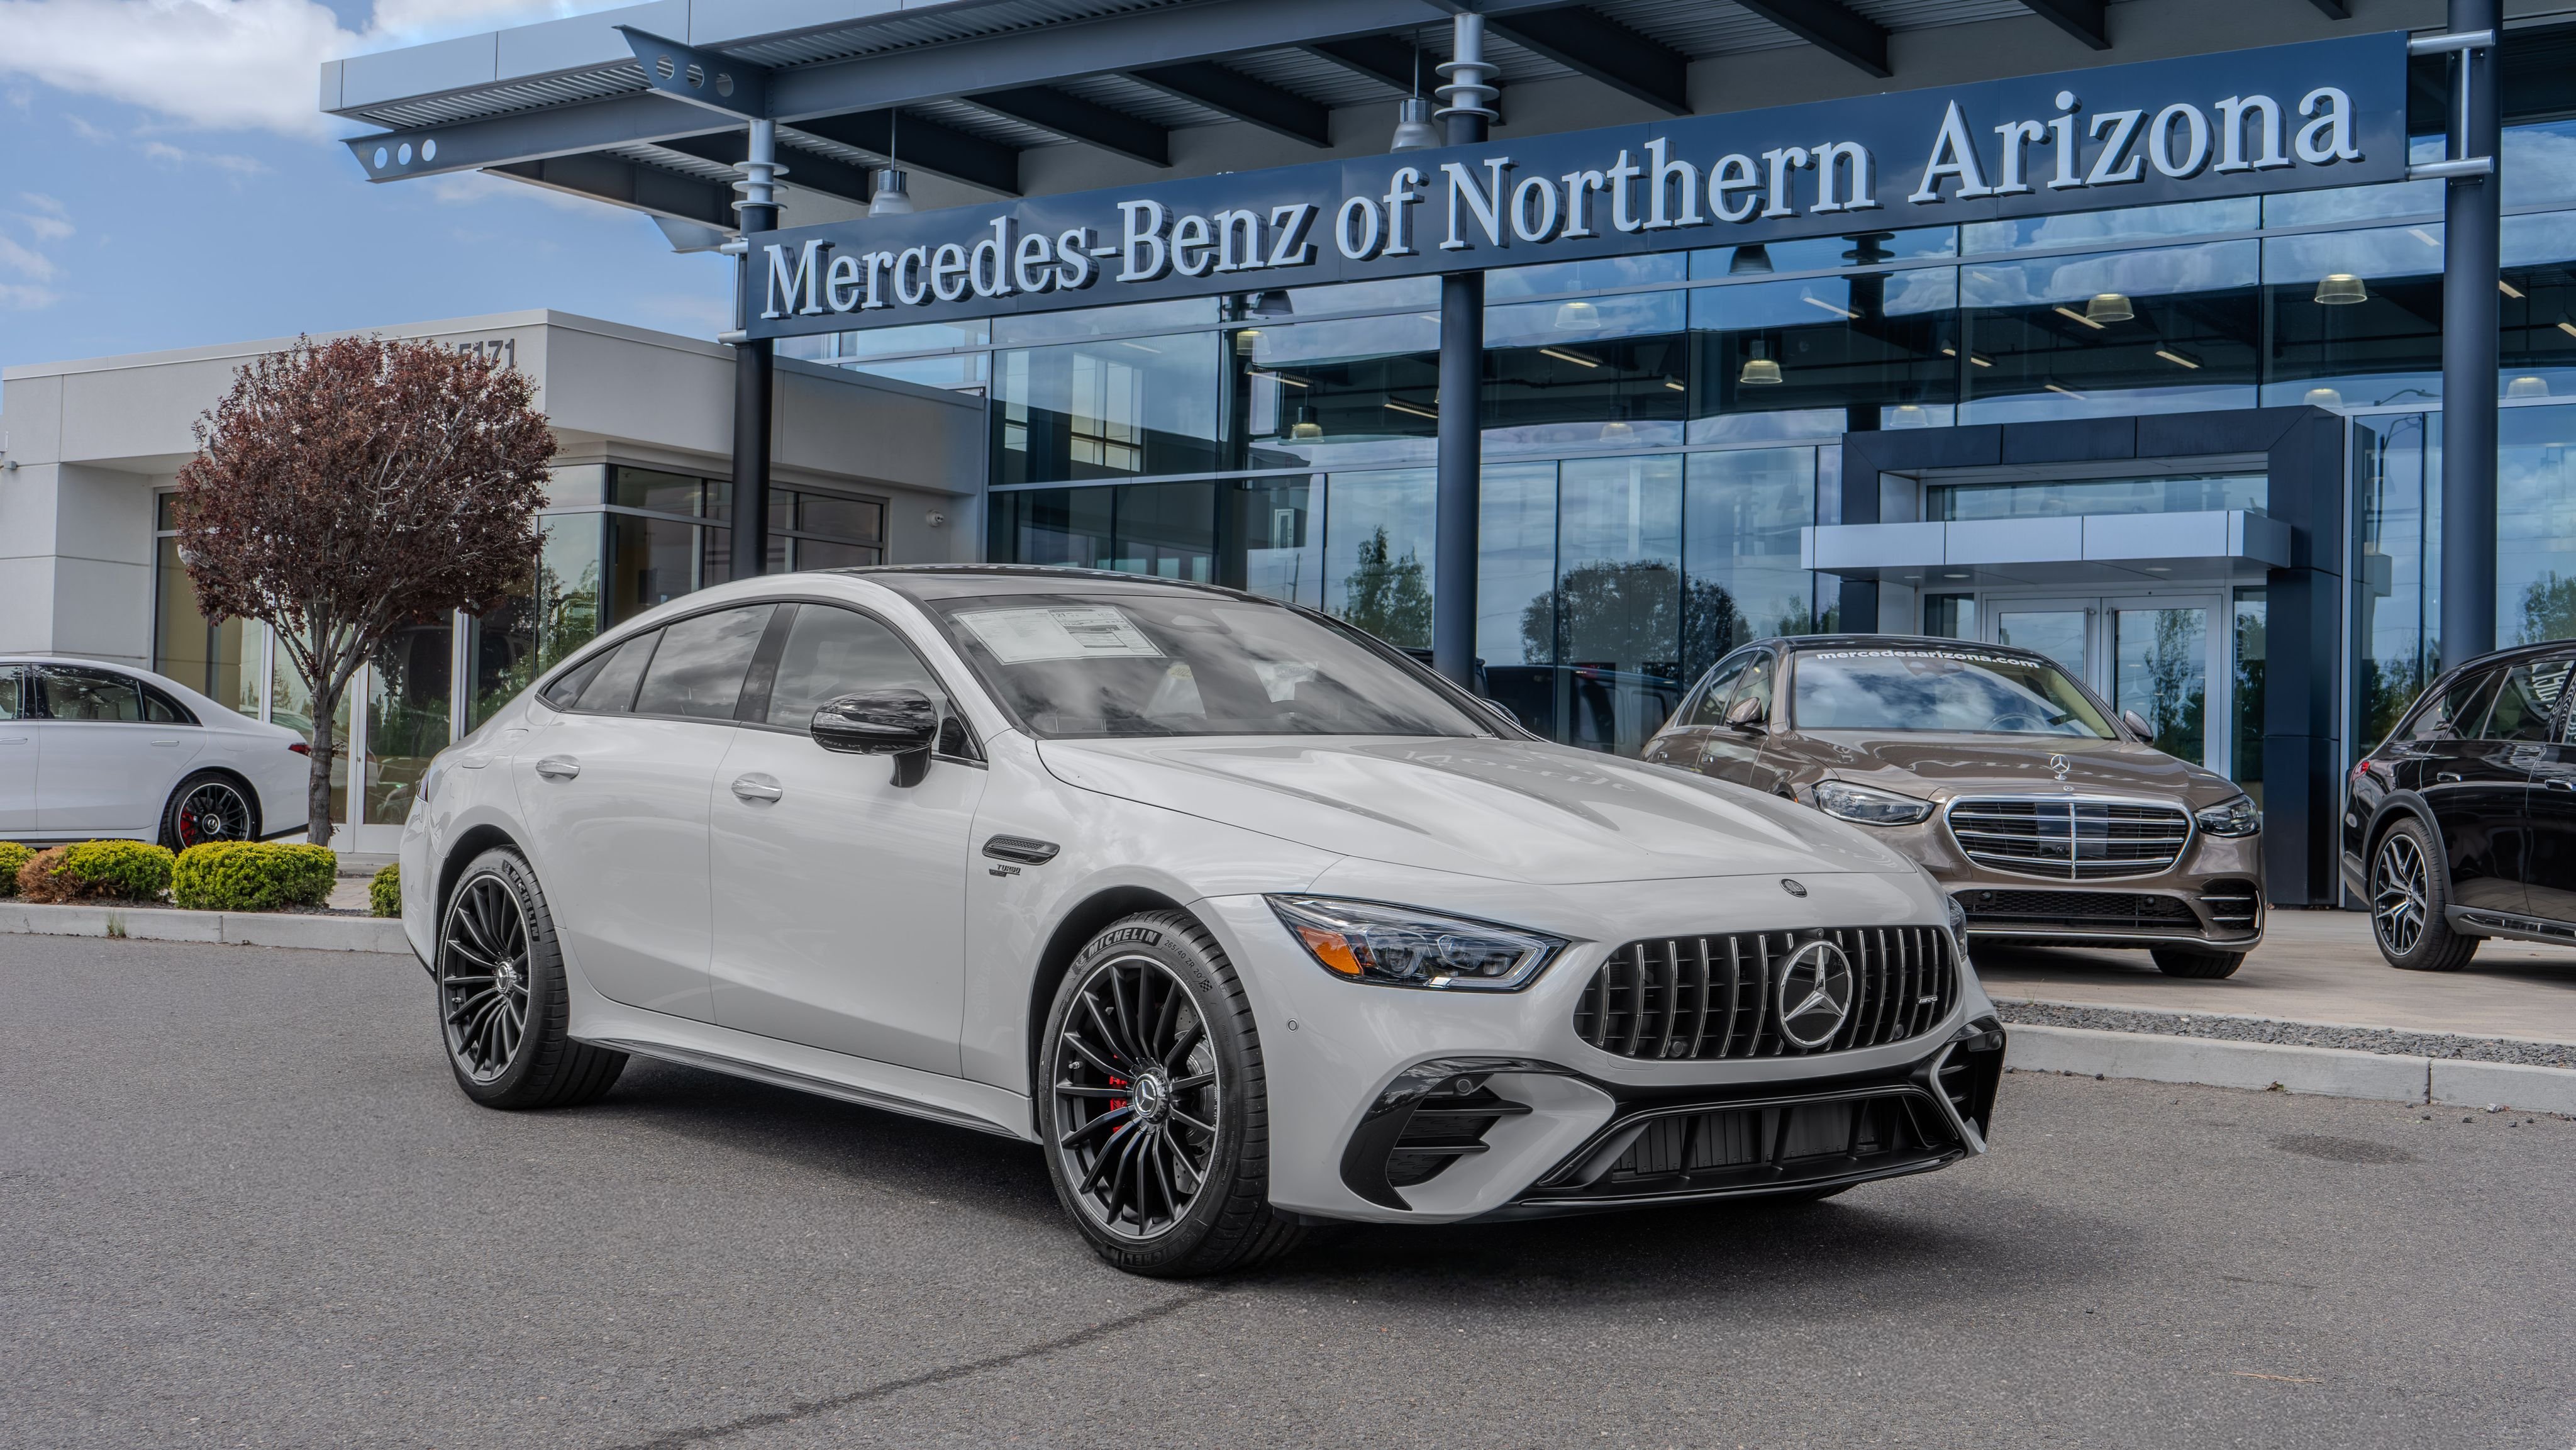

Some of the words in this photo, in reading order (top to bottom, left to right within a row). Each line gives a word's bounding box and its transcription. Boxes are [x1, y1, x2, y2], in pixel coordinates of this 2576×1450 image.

[760, 199, 1319, 320] Mercedes-Benz
[1335, 167, 1430, 261] of
[1439, 137, 1884, 251] Northern
[1907, 87, 2365, 205] Arizona
[1816, 649, 2040, 669] mercedesarizona.com
[997, 864, 1021, 873] TURBO
[510, 870, 539, 937] MICHELIN
[1089, 928, 1157, 958] MICHELIN
[1164, 940, 1187, 959] 265/40
[1185, 957, 1195, 968] ZR
[1194, 969, 1202, 979] 20
